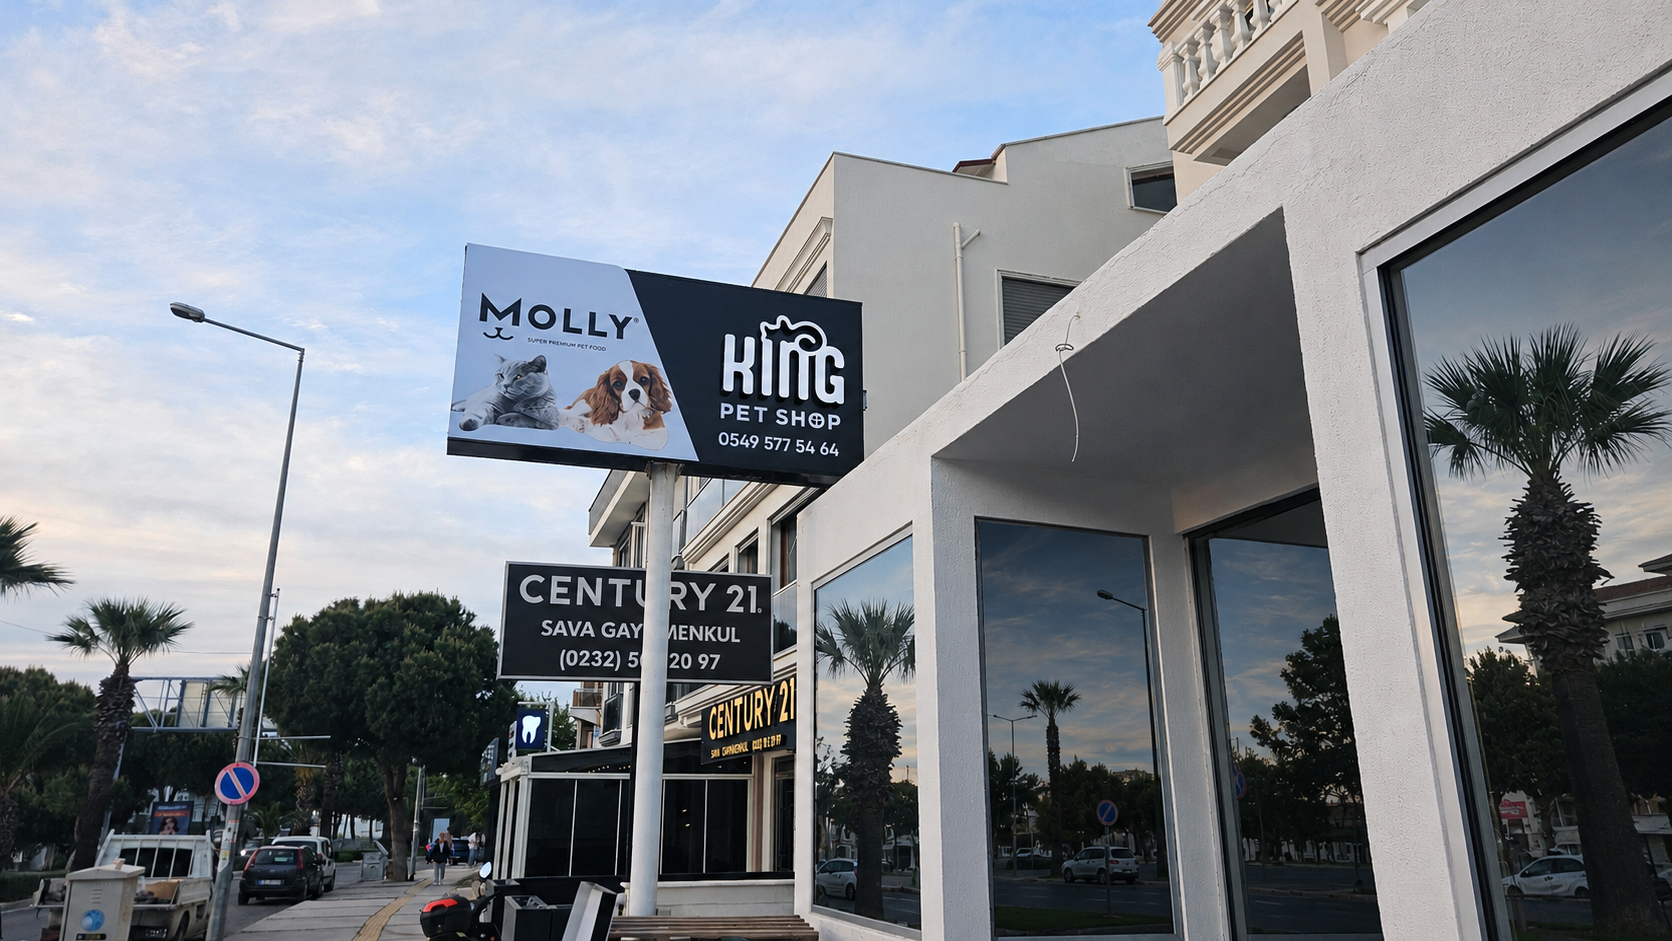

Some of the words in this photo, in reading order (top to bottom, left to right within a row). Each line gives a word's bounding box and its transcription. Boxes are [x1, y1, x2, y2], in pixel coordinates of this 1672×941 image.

[527, 337, 548, 345] SUPER
[548, 339, 577, 348] PREMIUM
[589, 344, 607, 352] FOOD
[720, 402, 768, 423] PET
[775, 408, 841, 430] SHOP
[718, 431, 760, 449] 0549
[764, 436, 791, 452] 577
[795, 439, 816, 455] 54
[820, 442, 840, 457] 64
[541, 619, 596, 637] SAVA
[559, 649, 621, 671] (0232)
[668, 652, 692, 670] 20
[697, 653, 721, 670] 97
[708, 685, 776, 741] CENTURY
[779, 677, 795, 723] 21
